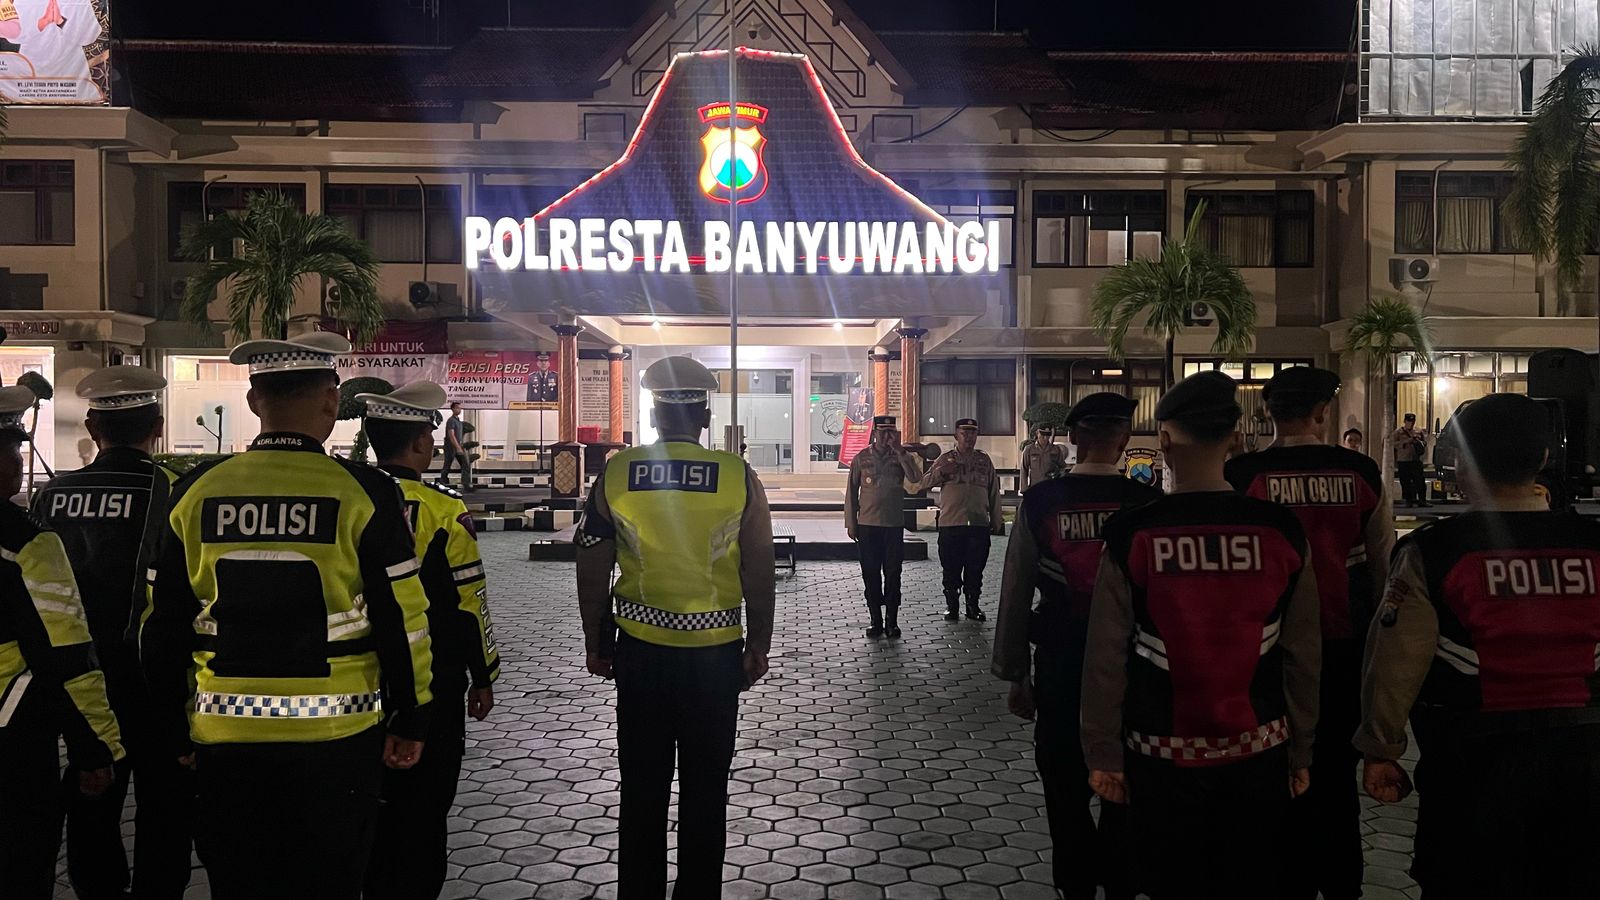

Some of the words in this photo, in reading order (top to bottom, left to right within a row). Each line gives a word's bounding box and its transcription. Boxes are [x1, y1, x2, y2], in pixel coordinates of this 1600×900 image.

[707, 106, 731, 117] JAWA
[465, 216, 691, 272] POLRESTA
[705, 220, 999, 274] BANYUWANGI
[381, 342, 425, 353] UNTUK
[338, 357, 426, 368] MASYARAKAT
[448, 362, 491, 374] RENSI
[494, 362, 531, 374] PERS
[459, 376, 524, 384] BANYUWANGI
[257, 436, 302, 446] KORLANTAS
[635, 463, 710, 487] POLISI
[1269, 477, 1306, 504] PAM
[1308, 476, 1352, 503] OBVIT
[51, 493, 133, 519] POLISI
[216, 503, 317, 536] POLISI
[1060, 512, 1095, 540] PAM
[1152, 534, 1262, 573] POLISI
[1485, 558, 1595, 596] POLISI
